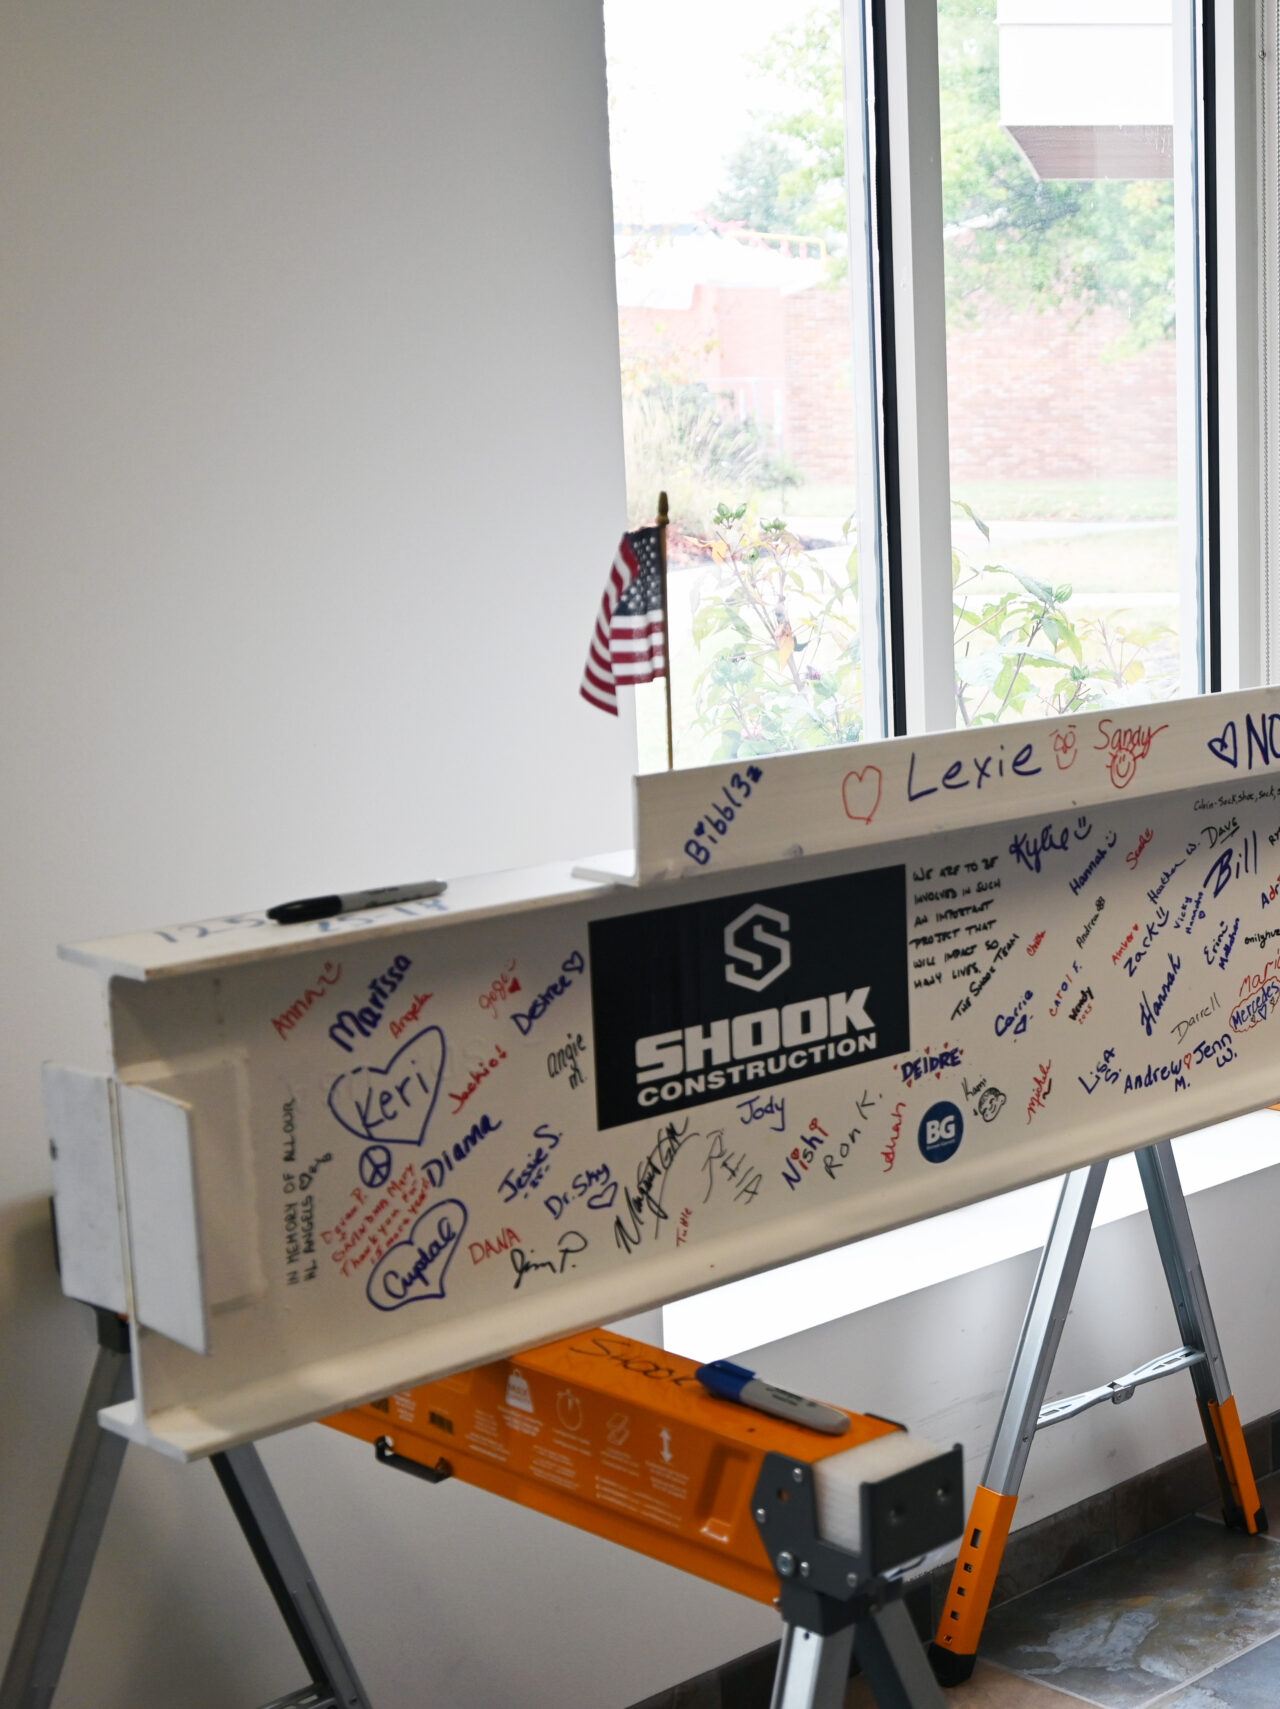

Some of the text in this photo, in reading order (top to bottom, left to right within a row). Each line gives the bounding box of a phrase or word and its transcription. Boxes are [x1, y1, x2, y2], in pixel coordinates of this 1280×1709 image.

[908, 743, 1042, 802] Lexie
[913, 856, 999, 882] WE ARE TO BE
[1009, 824, 1070, 874] Kylie
[1069, 848, 1108, 897] Hannah
[1202, 829, 1258, 899] Bill
[914, 878, 1002, 906] INVOLVED IN SUCH
[914, 899, 994, 928] AN IMPORTANT
[909, 919, 997, 949] PROJECT THAT
[913, 939, 1000, 969] WILL IMPACT SO
[914, 972, 942, 990] MANY
[950, 997, 973, 1021] THE
[993, 933, 1020, 965] TEAM
[1048, 973, 1074, 1018] Carol
[1139, 952, 1181, 1038] Hannah
[327, 953, 414, 1053] Marissa
[388, 991, 435, 1040] Angela
[1231, 980, 1280, 1031] Mercedes
[635, 986, 875, 1085] SHOOK
[1193, 1033, 1233, 1064] Jenn
[637, 1032, 877, 1107] CONSTRUCTION
[901, 1047, 962, 1082] DEIDRE
[1124, 1059, 1182, 1095] Andrew
[1174, 1075, 1191, 1093] M.
[354, 1060, 430, 1140] Keri
[736, 1094, 788, 1133] Jody
[925, 1114, 956, 1145] BG
[822, 1128, 862, 1181] Ron
[281, 1097, 299, 1287] IN MEMORY OF ALL OUR
[301, 1194, 317, 1254] ANGELS
[467, 1226, 523, 1266] DANA
